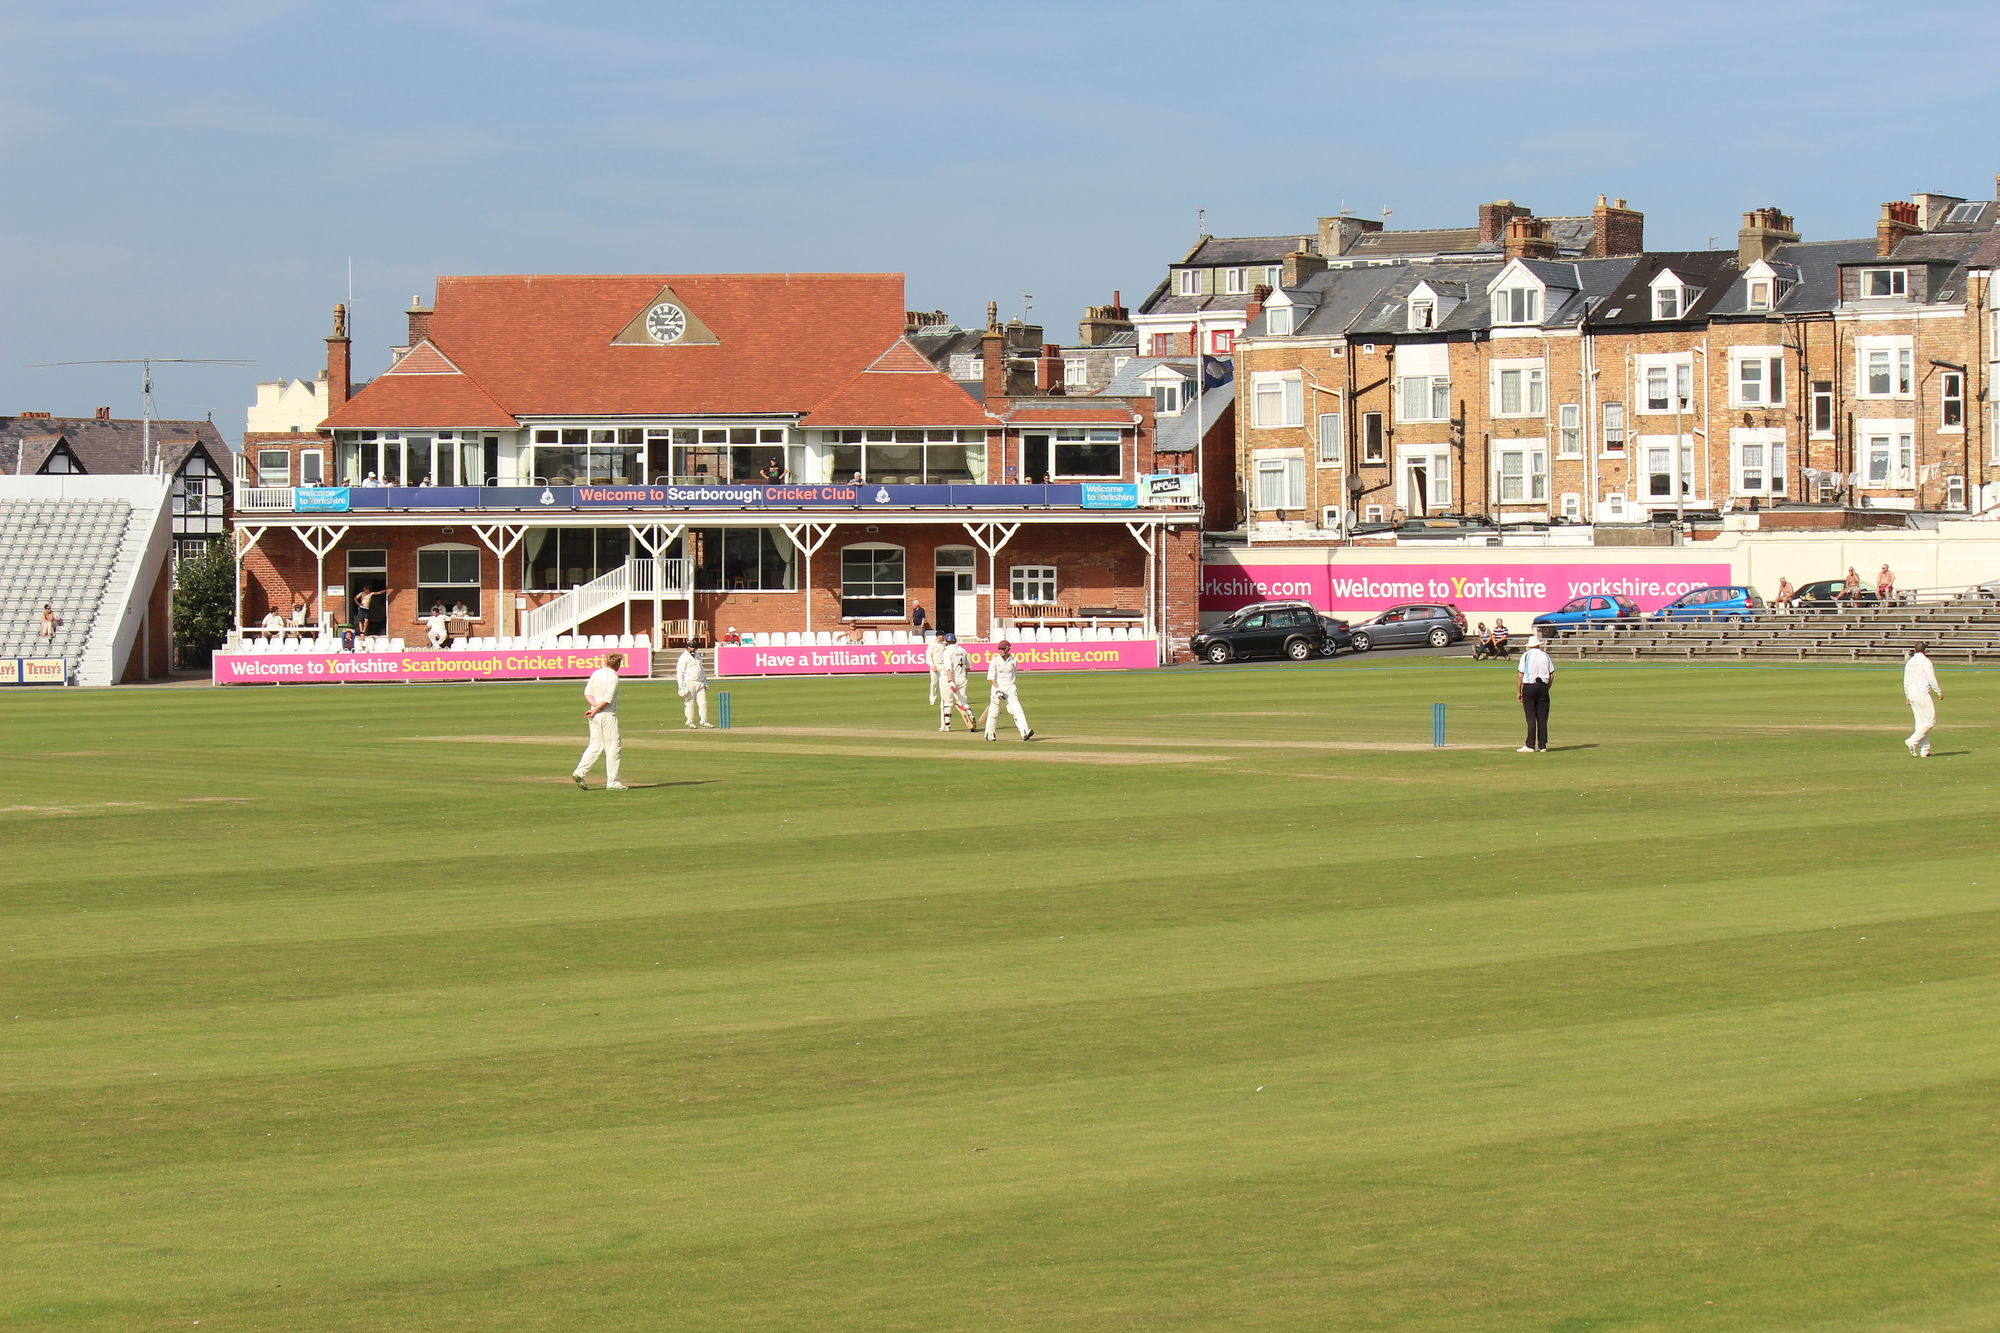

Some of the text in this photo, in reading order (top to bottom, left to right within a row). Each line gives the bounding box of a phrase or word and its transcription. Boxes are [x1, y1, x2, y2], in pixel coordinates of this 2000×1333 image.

[1086, 485, 1123, 493] Welcome
[1151, 479, 1180, 492] McCain
[579, 486, 856, 504] Welcome to Scarborough Cricket Club
[1087, 493, 1135, 502] to Yorkshire
[1199, 578, 1312, 597] rkshire.com
[1332, 577, 1546, 599] Welcome to Yorkshire
[231, 653, 630, 676] Welcome to Yorkshire Scarborough Cricket Festil
[755, 653, 794, 667] Have
[798, 655, 809, 667] a
[812, 651, 878, 666] brilliant
